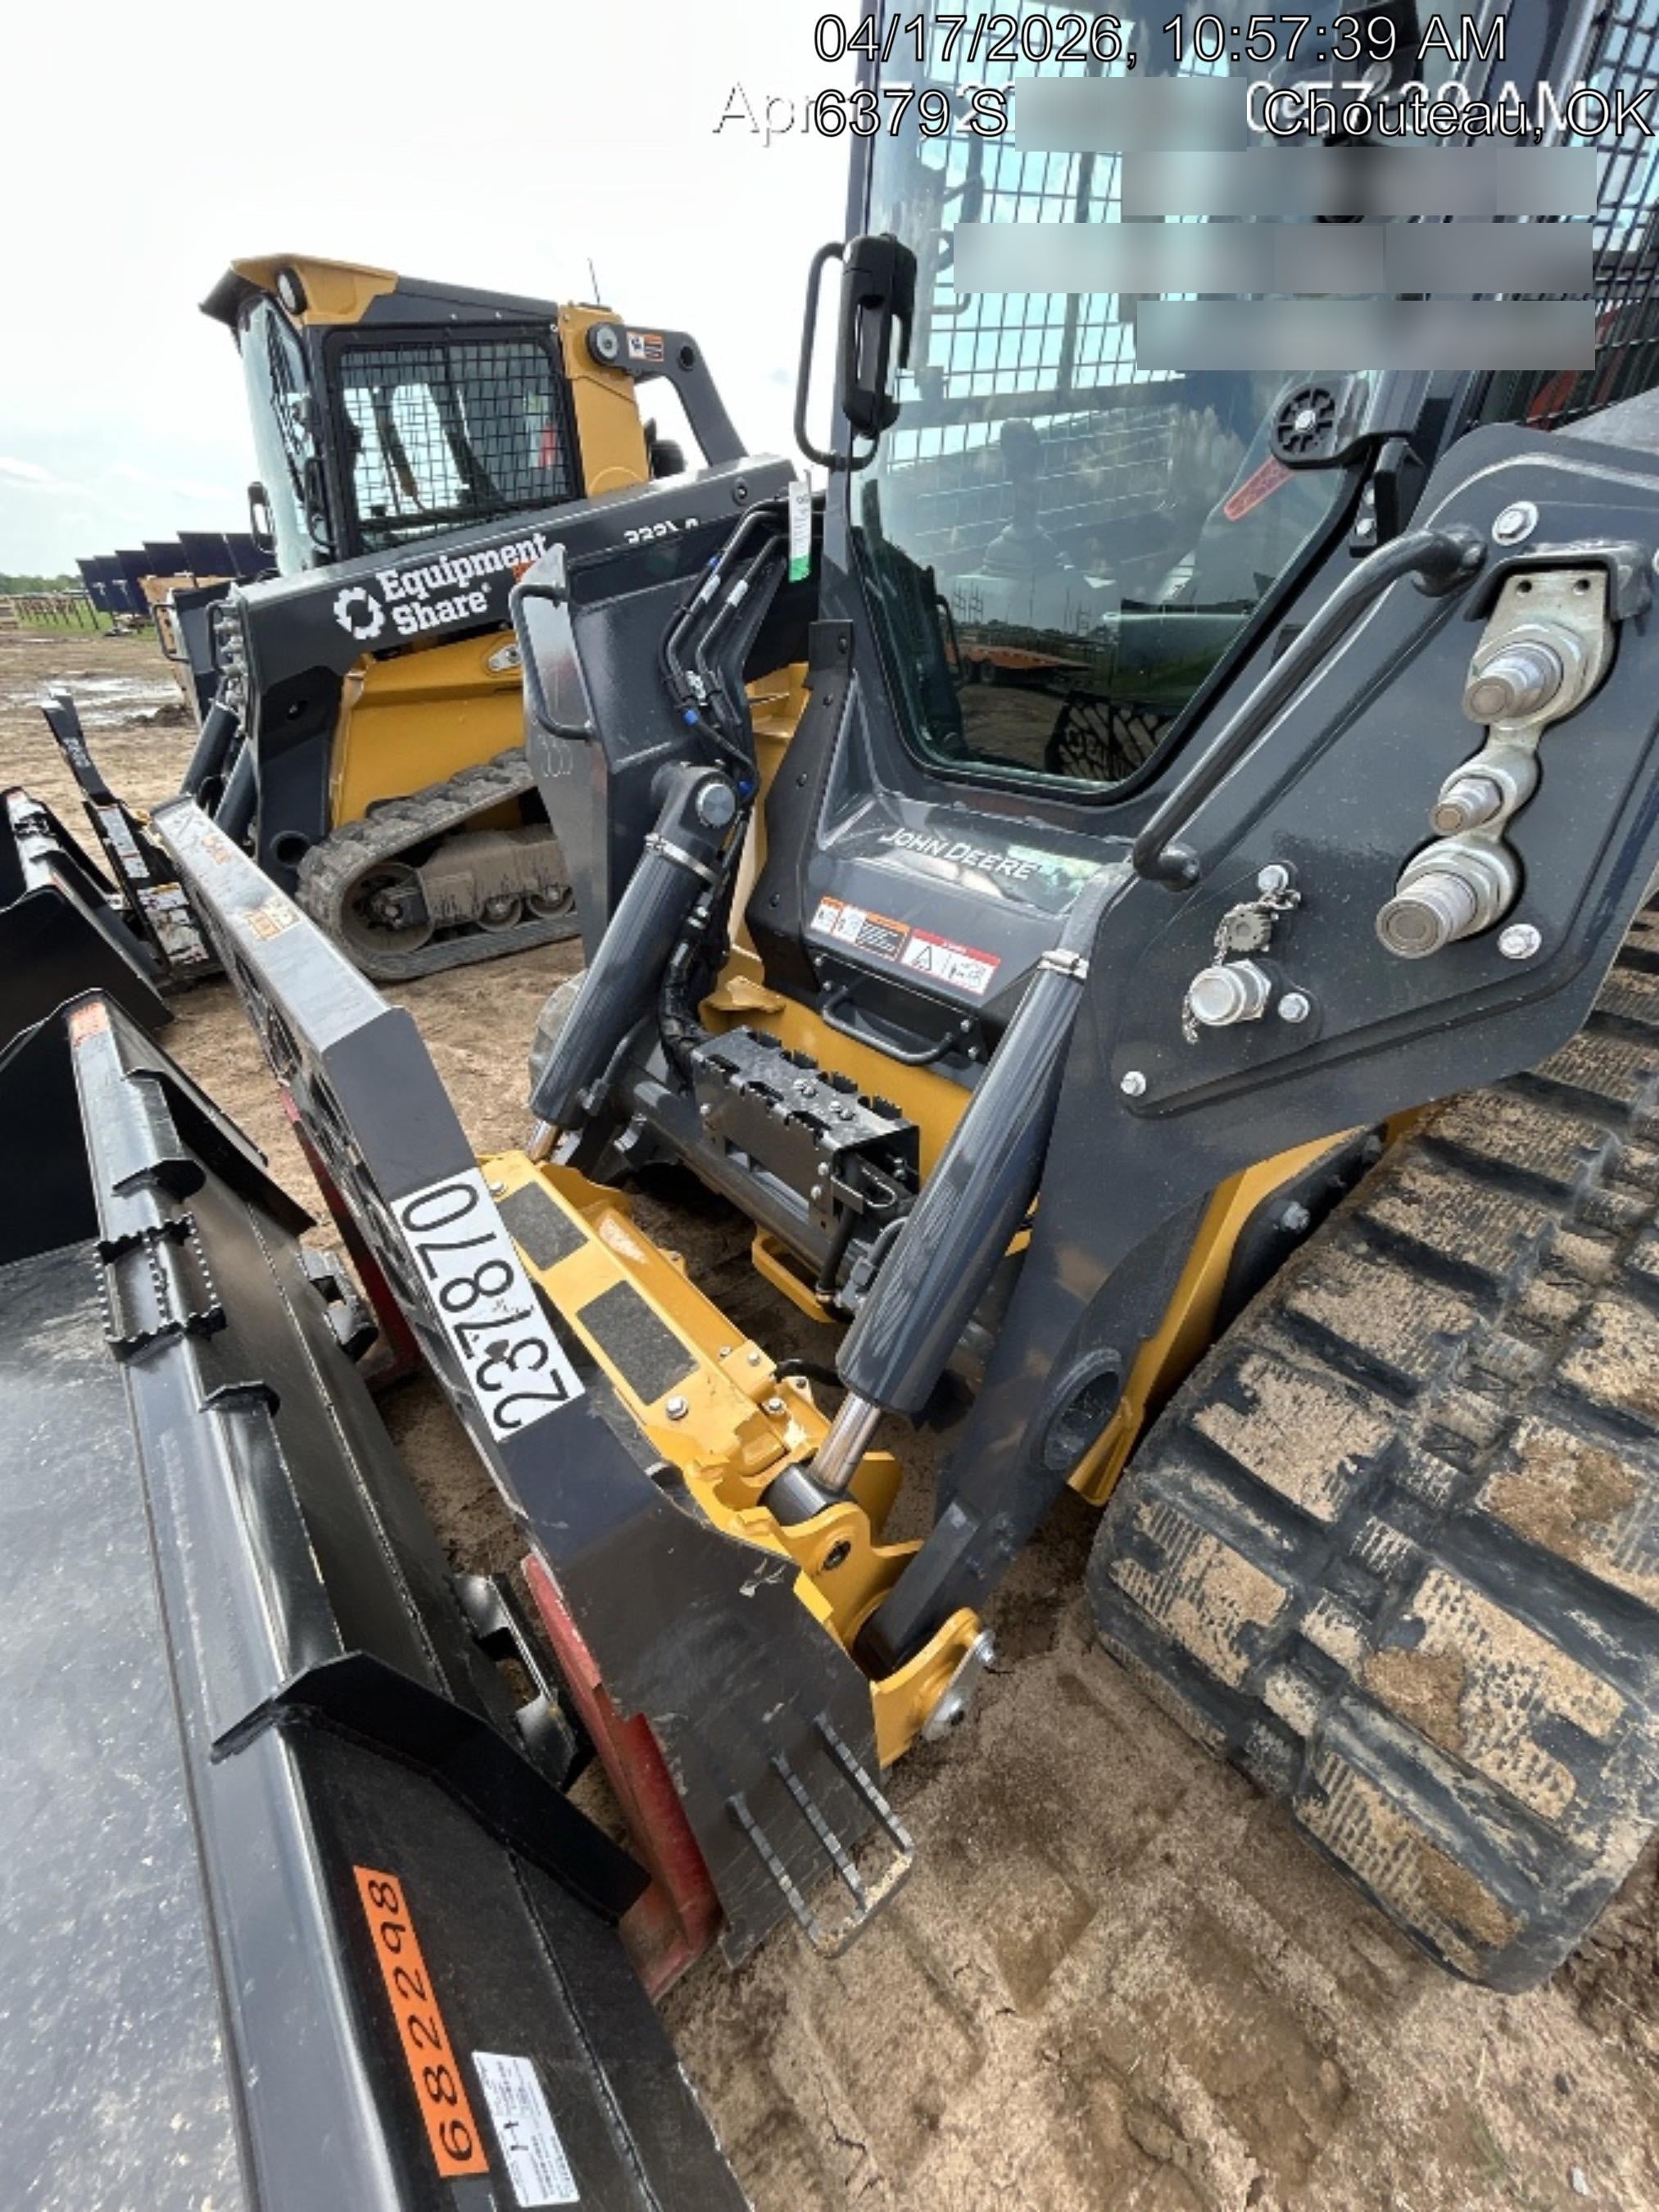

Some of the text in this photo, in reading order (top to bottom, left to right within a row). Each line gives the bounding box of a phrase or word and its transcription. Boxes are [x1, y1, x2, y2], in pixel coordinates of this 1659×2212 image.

[375, 533, 547, 601] Equipment
[877, 827, 1039, 881] JOHN DEERE
[401, 1184, 569, 1429] 237870
[369, 1879, 473, 2162] 682298
